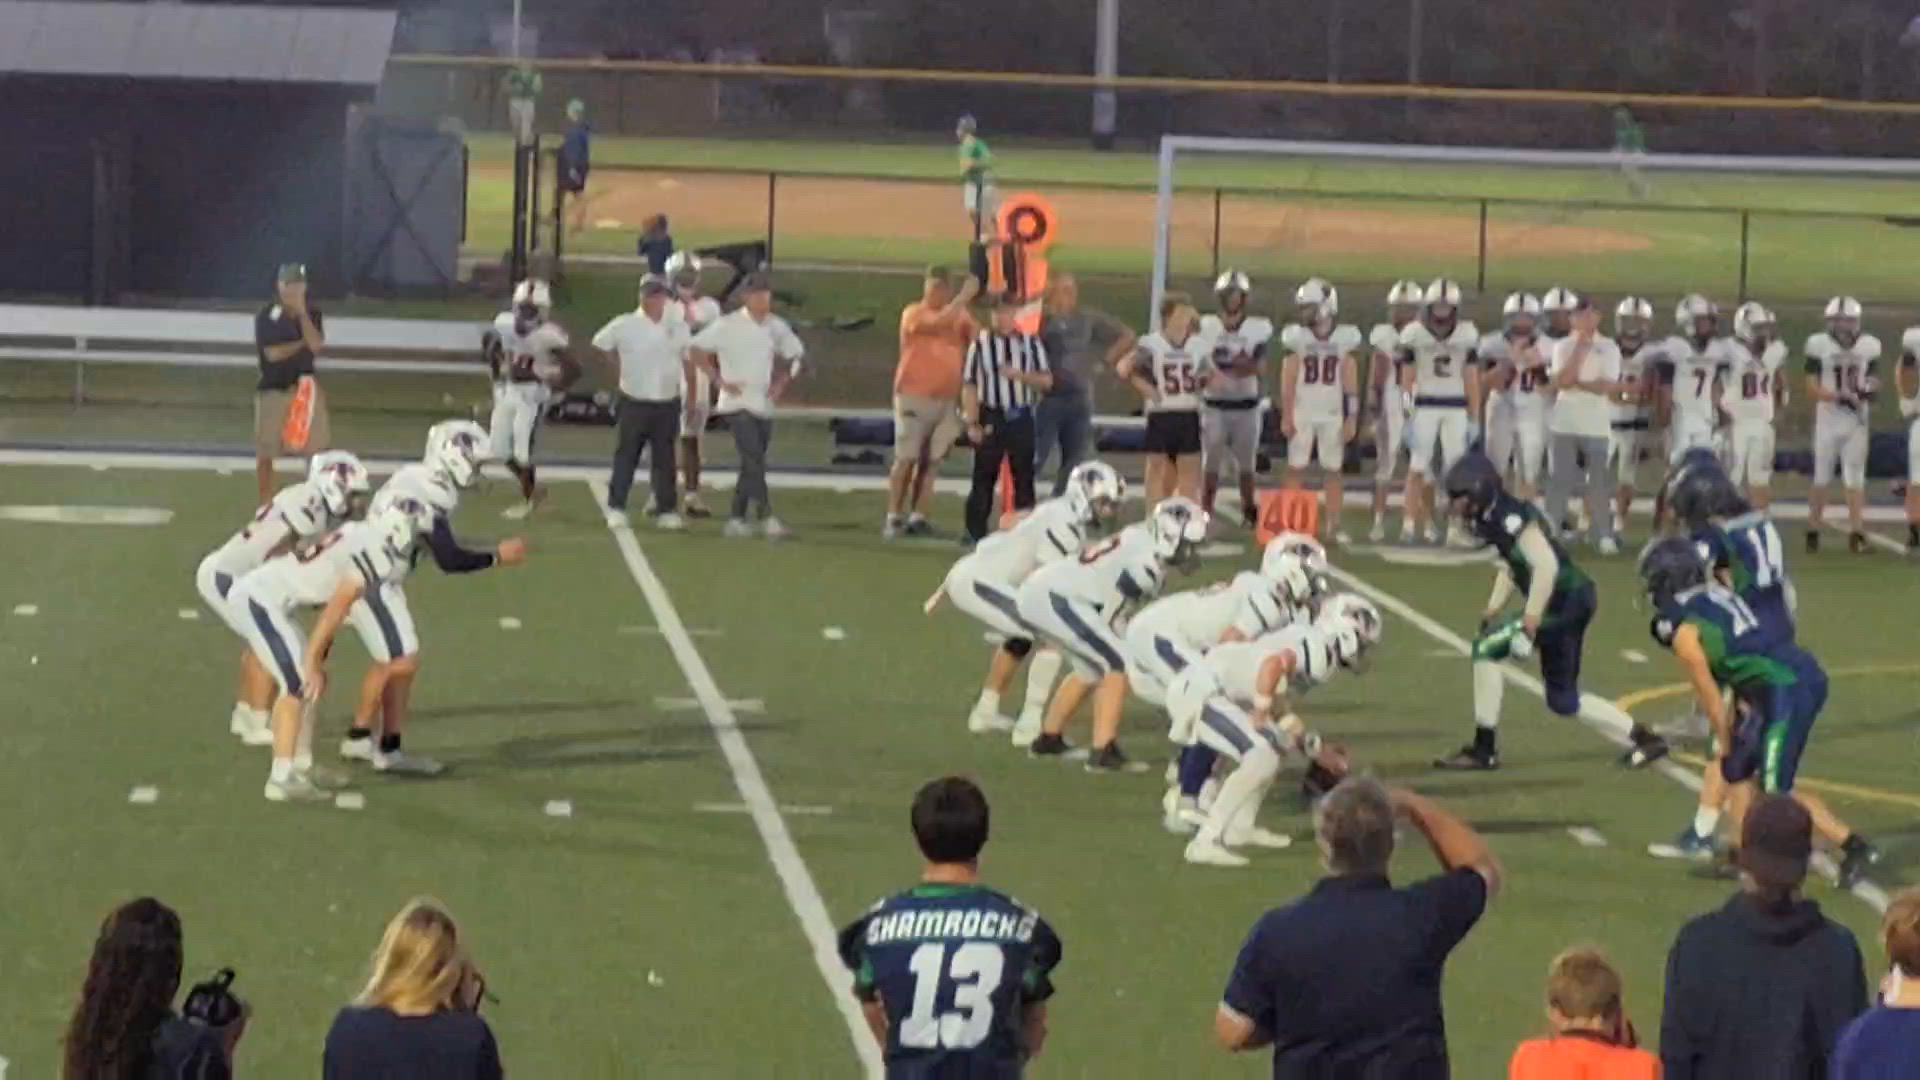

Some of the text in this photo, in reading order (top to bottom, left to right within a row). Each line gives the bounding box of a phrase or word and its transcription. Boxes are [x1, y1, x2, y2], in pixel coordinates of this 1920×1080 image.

[1163, 363, 1195, 395] 55
[1693, 367, 1706, 400] 7
[1263, 494, 1311, 533] 40
[866, 910, 1038, 945] SHAMROCKS
[899, 942, 1005, 1050] 13
